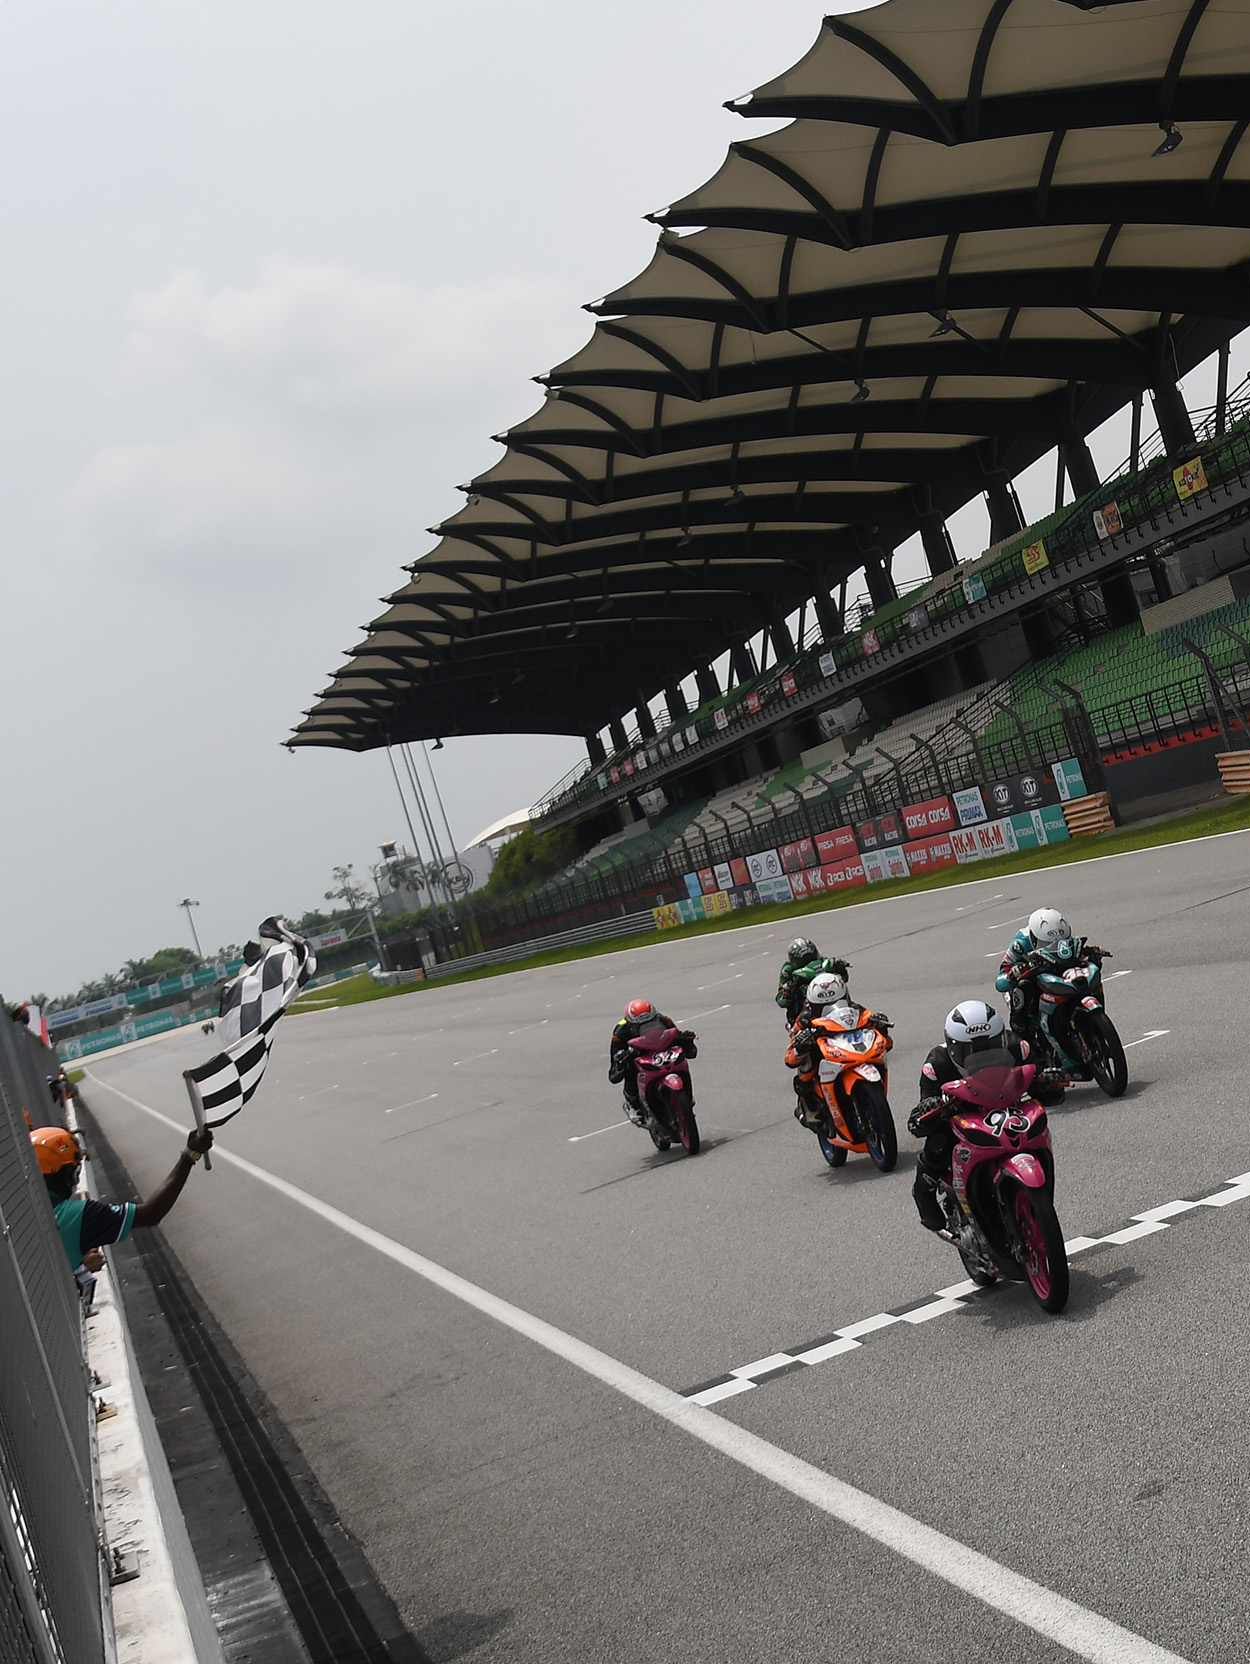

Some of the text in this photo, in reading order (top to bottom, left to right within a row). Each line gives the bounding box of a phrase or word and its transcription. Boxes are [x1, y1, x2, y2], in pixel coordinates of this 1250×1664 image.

[790, 873, 807, 893] NGK
[807, 869, 825, 889] NGK
[136, 1016, 174, 1032] PETRONAS
[966, 1023, 991, 1035] NHK
[81, 1033, 122, 1050] PETRONAS
[983, 1107, 1030, 1136] 95
